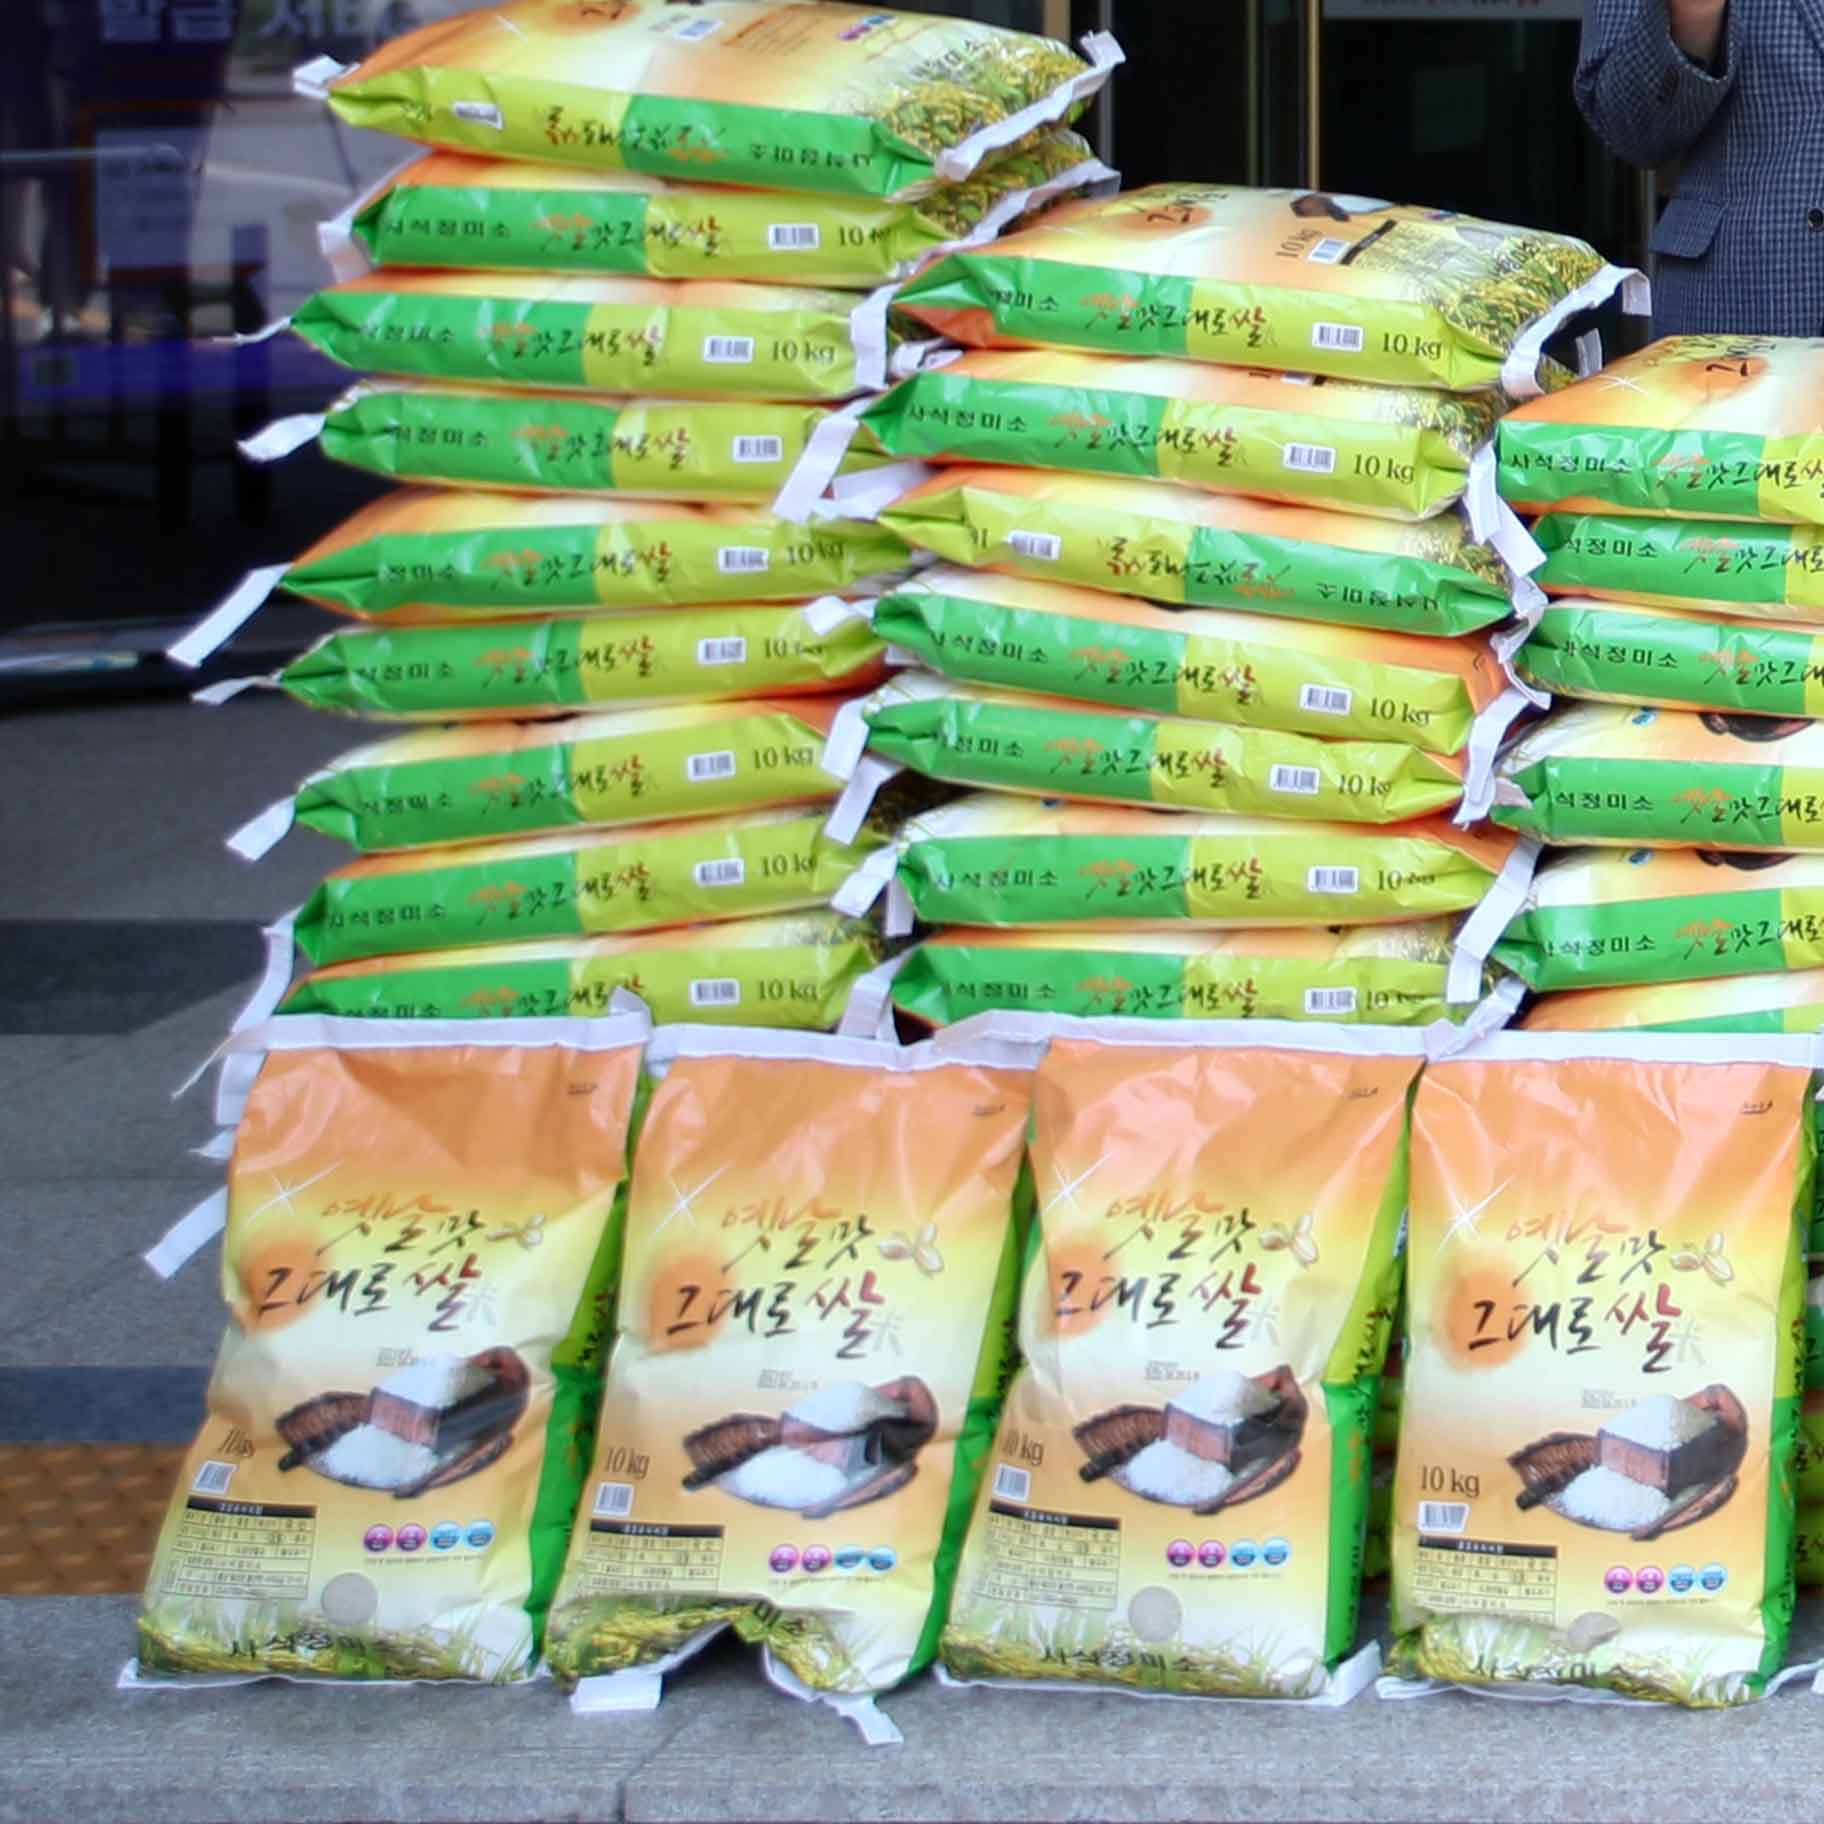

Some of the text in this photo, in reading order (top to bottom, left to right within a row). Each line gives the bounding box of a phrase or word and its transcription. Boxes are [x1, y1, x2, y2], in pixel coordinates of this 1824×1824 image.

[770, 338, 836, 367] 10 kg
[1382, 333, 1443, 361] 10 kg
[1352, 455, 1415, 484] 10 kg
[1370, 699, 1396, 719] 10
[757, 980, 782, 999] 10
[605, 1450, 650, 1481] 10 kg
[1020, 1438, 1043, 1465] kg
[1418, 1466, 1481, 1499] 10 kg
